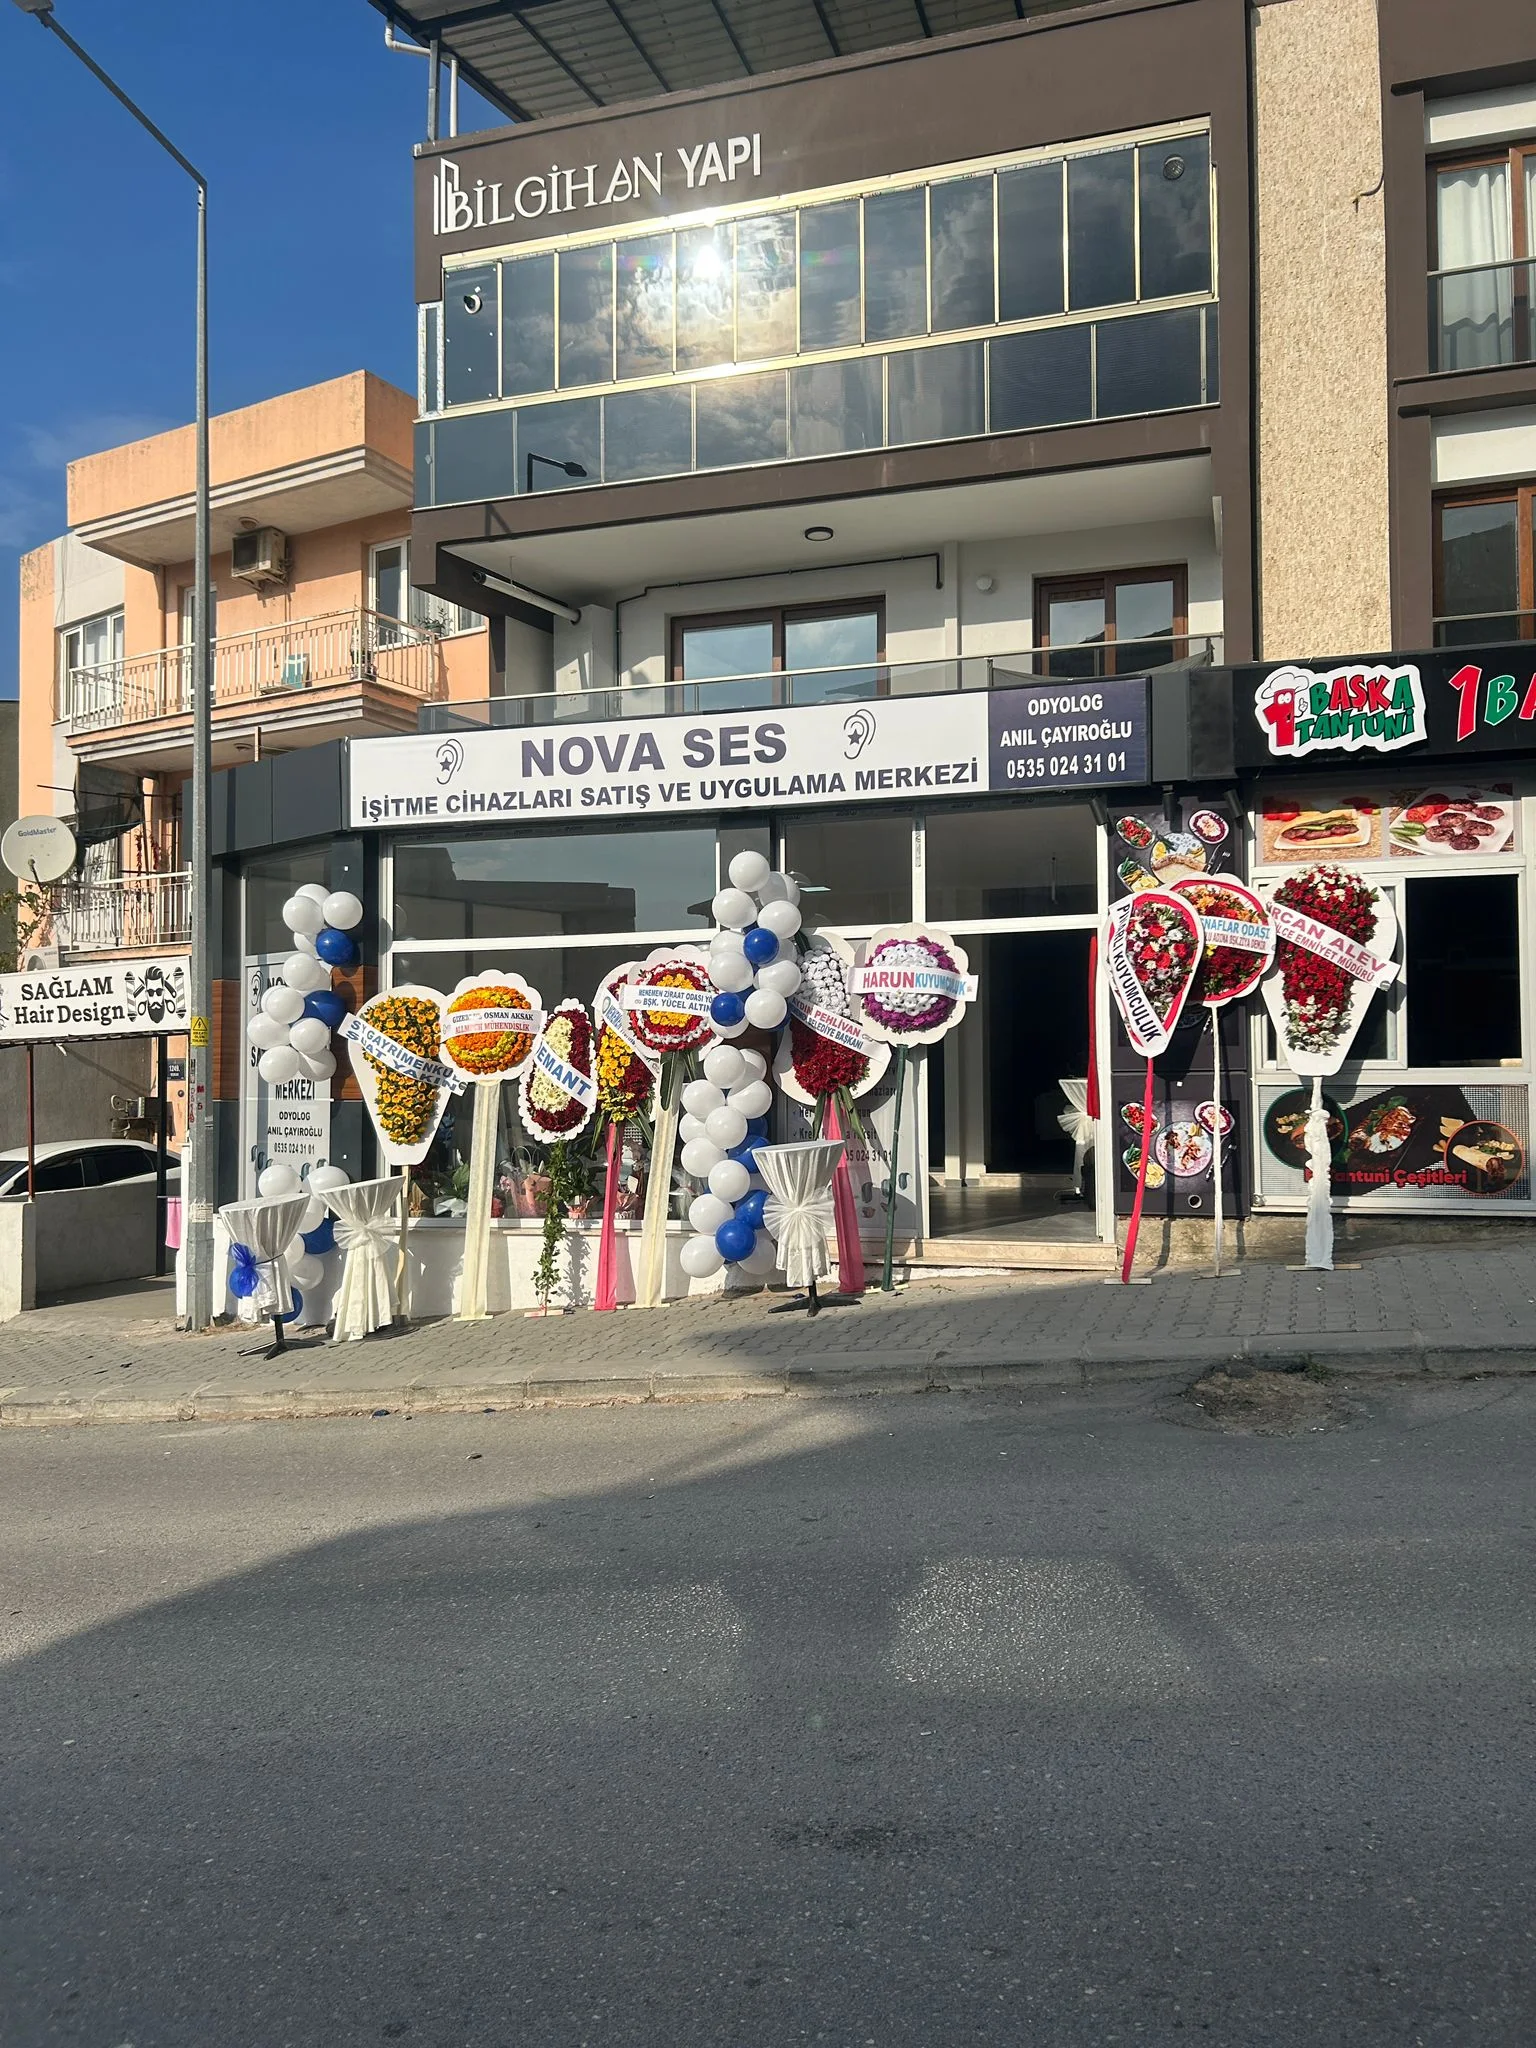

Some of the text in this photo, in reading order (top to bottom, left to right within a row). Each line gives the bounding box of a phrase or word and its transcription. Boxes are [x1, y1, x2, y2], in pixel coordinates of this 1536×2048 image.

[433, 133, 761, 236] BİLGİHAN YAPI
[1028, 693, 1103, 716] ODYOLOG
[1000, 719, 1133, 749] ANIL ÇAYIROĞLU
[521, 722, 787, 778] NOVA SES
[1007, 751, 1127, 780] 0535 024 31 01
[362, 757, 978, 823] İŞİTME CİHAZLARI SATIŞ VE UYGULAMA MERKEZİ
[1295, 933, 1338, 960] EMNİYET
[1337, 954, 1375, 982] MÜDÜRÜ
[1329, 937, 1387, 972] ALEV
[21, 976, 114, 1001] SAĞLAM
[862, 971, 915, 989] HARUN
[661, 998, 687, 1009] YÜCEL
[1113, 950, 1162, 1043] KUYUMCULUK
[14, 1002, 125, 1026] Hair Design
[484, 1011, 510, 1020] OSMAN
[511, 1012, 534, 1021] AKSAK
[814, 1009, 861, 1037] PEHLİVAN
[366, 1030, 461, 1082] GAYRİMENKUL
[536, 1044, 592, 1096] EMANT
[279, 1111, 311, 1121] ODYOLOG
[267, 1125, 323, 1138] ANIL ÇAYIROĞLU
[274, 1142, 288, 1153] 0535
[299, 1144, 307, 1154] 31
[1331, 1168, 1390, 1184] antuni
[1393, 1168, 1468, 1189] Çeşitleri
